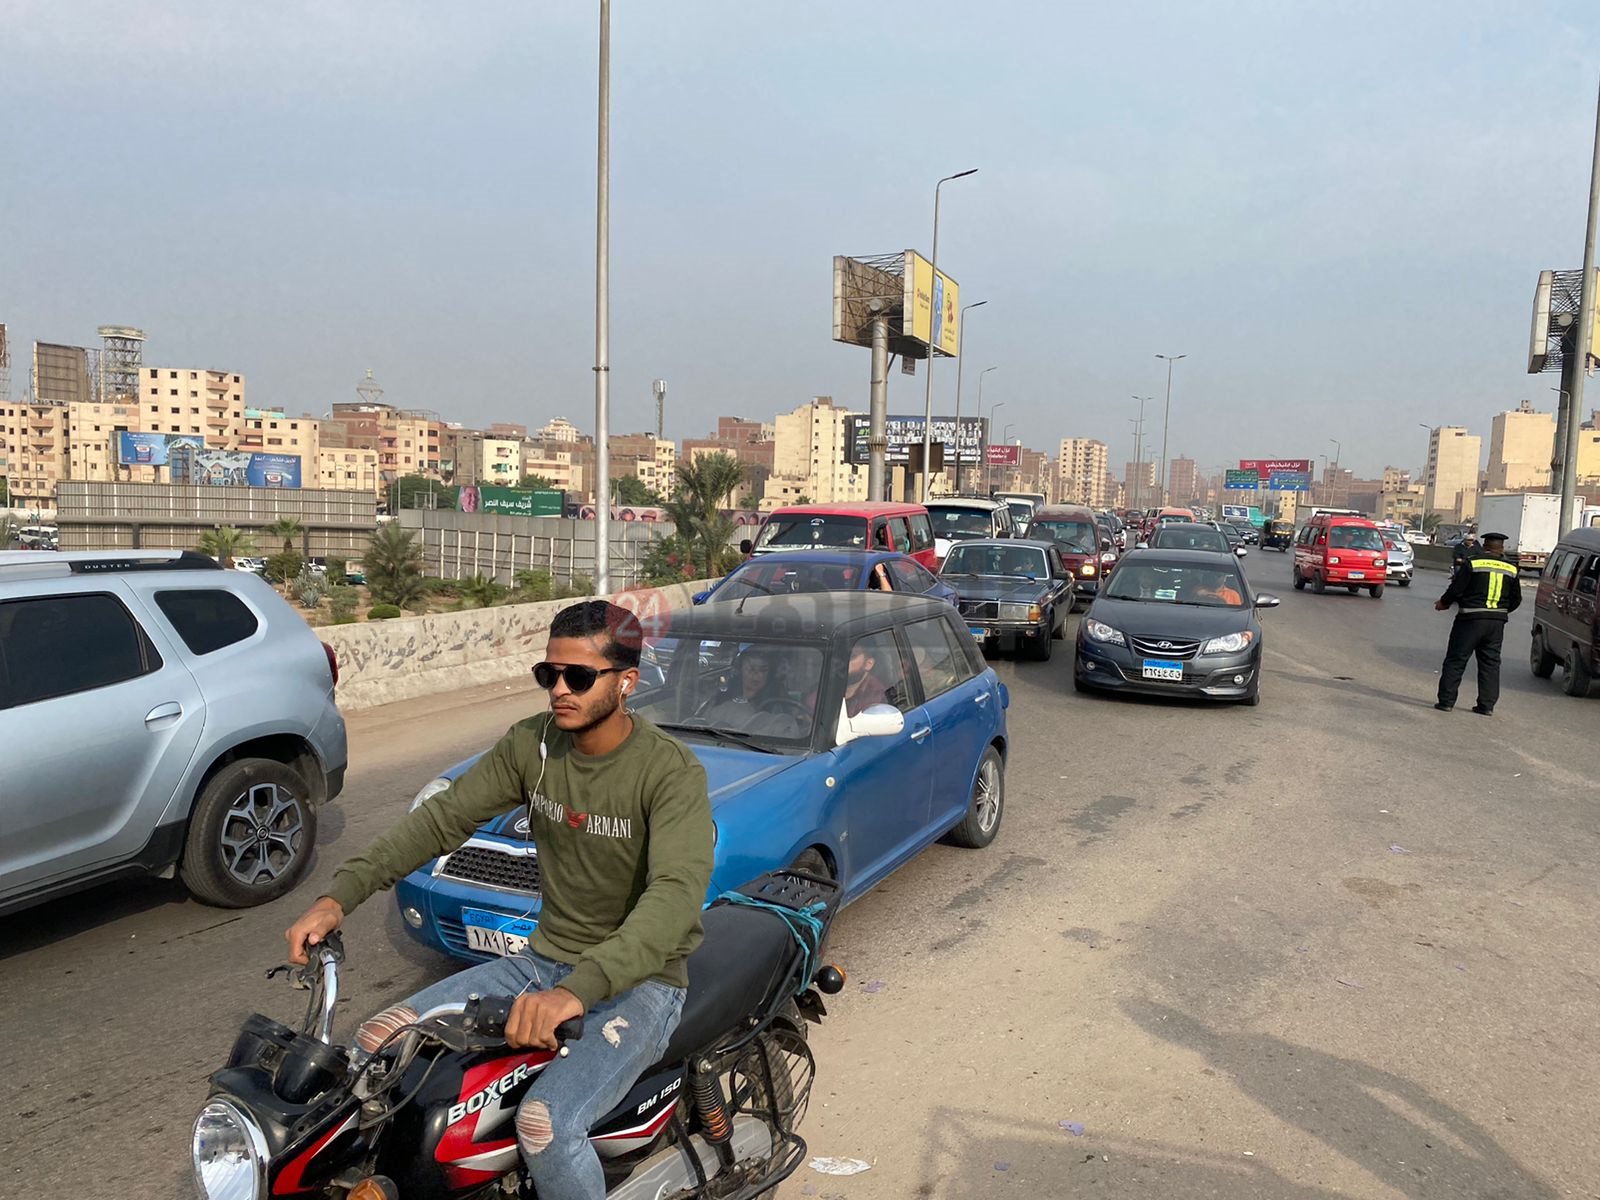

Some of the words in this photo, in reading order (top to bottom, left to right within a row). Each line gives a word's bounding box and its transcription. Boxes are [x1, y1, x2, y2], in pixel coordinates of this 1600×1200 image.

[484, 499, 499, 507] النصر
[500, 500, 514, 508] سيف
[515, 500, 532, 509] شريف
[586, 813, 632, 839] ARMANI
[446, 1062, 529, 1126] BOXER
[637, 1095, 657, 1116] BM
[659, 1077, 682, 1100] 150
